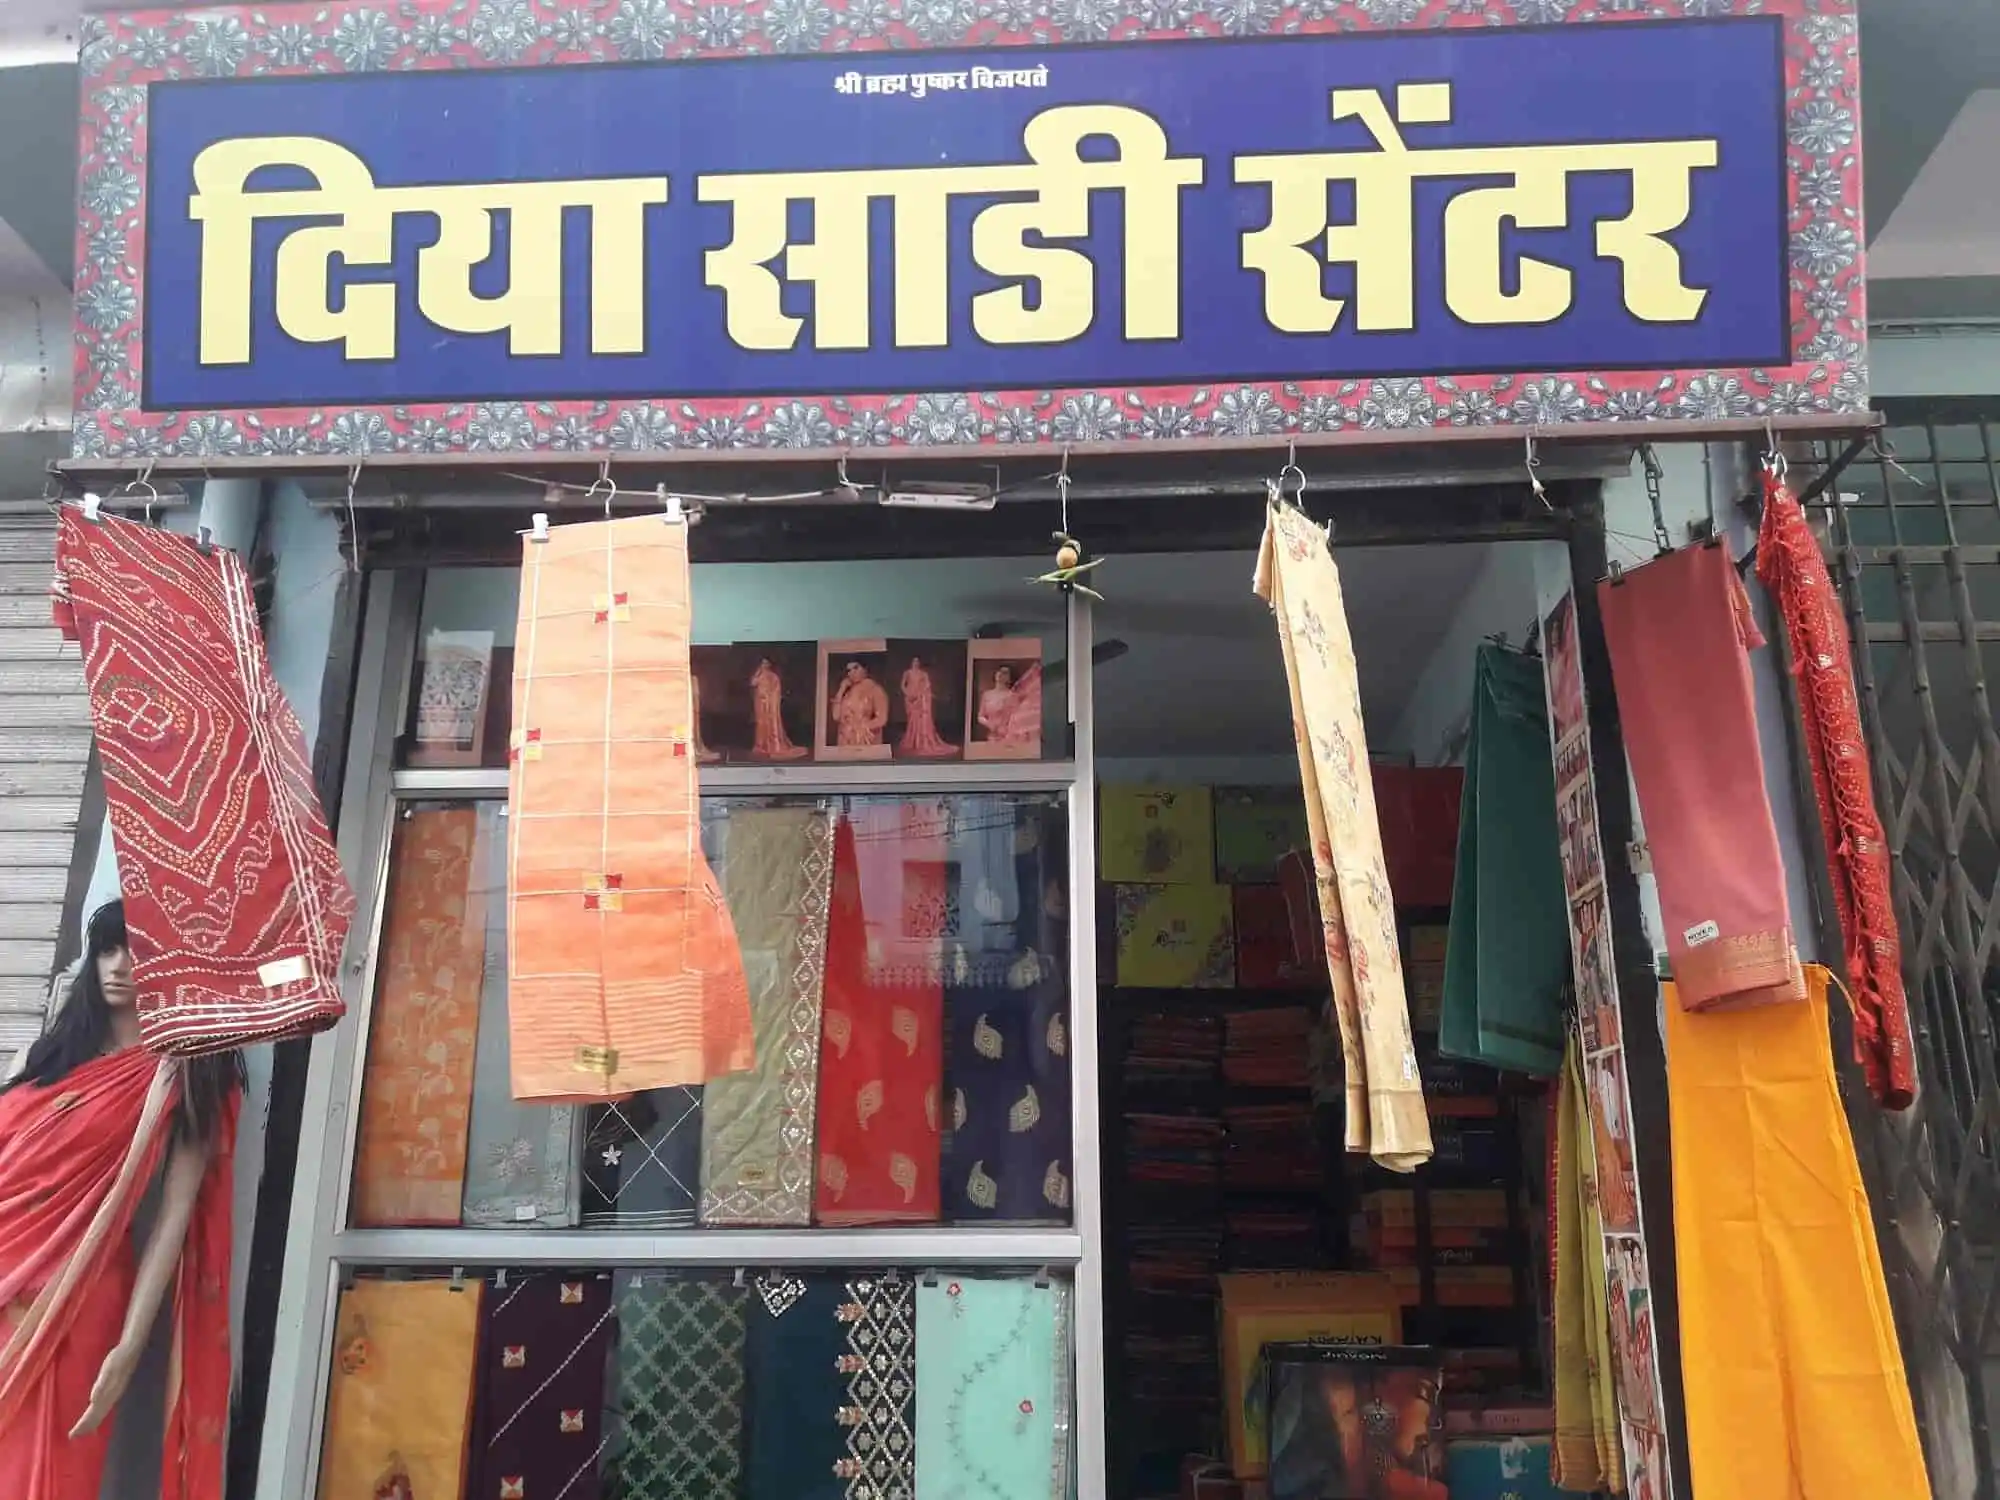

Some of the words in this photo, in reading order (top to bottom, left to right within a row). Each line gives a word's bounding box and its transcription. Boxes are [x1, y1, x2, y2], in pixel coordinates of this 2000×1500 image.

[834, 71, 862, 94] श्री
[910, 71, 969, 98] पुष्कर
[971, 63, 1049, 90] विजयते
[189, 135, 669, 366] दिया
[698, 104, 1204, 351] साडी
[1233, 82, 1718, 333] सेंटर
